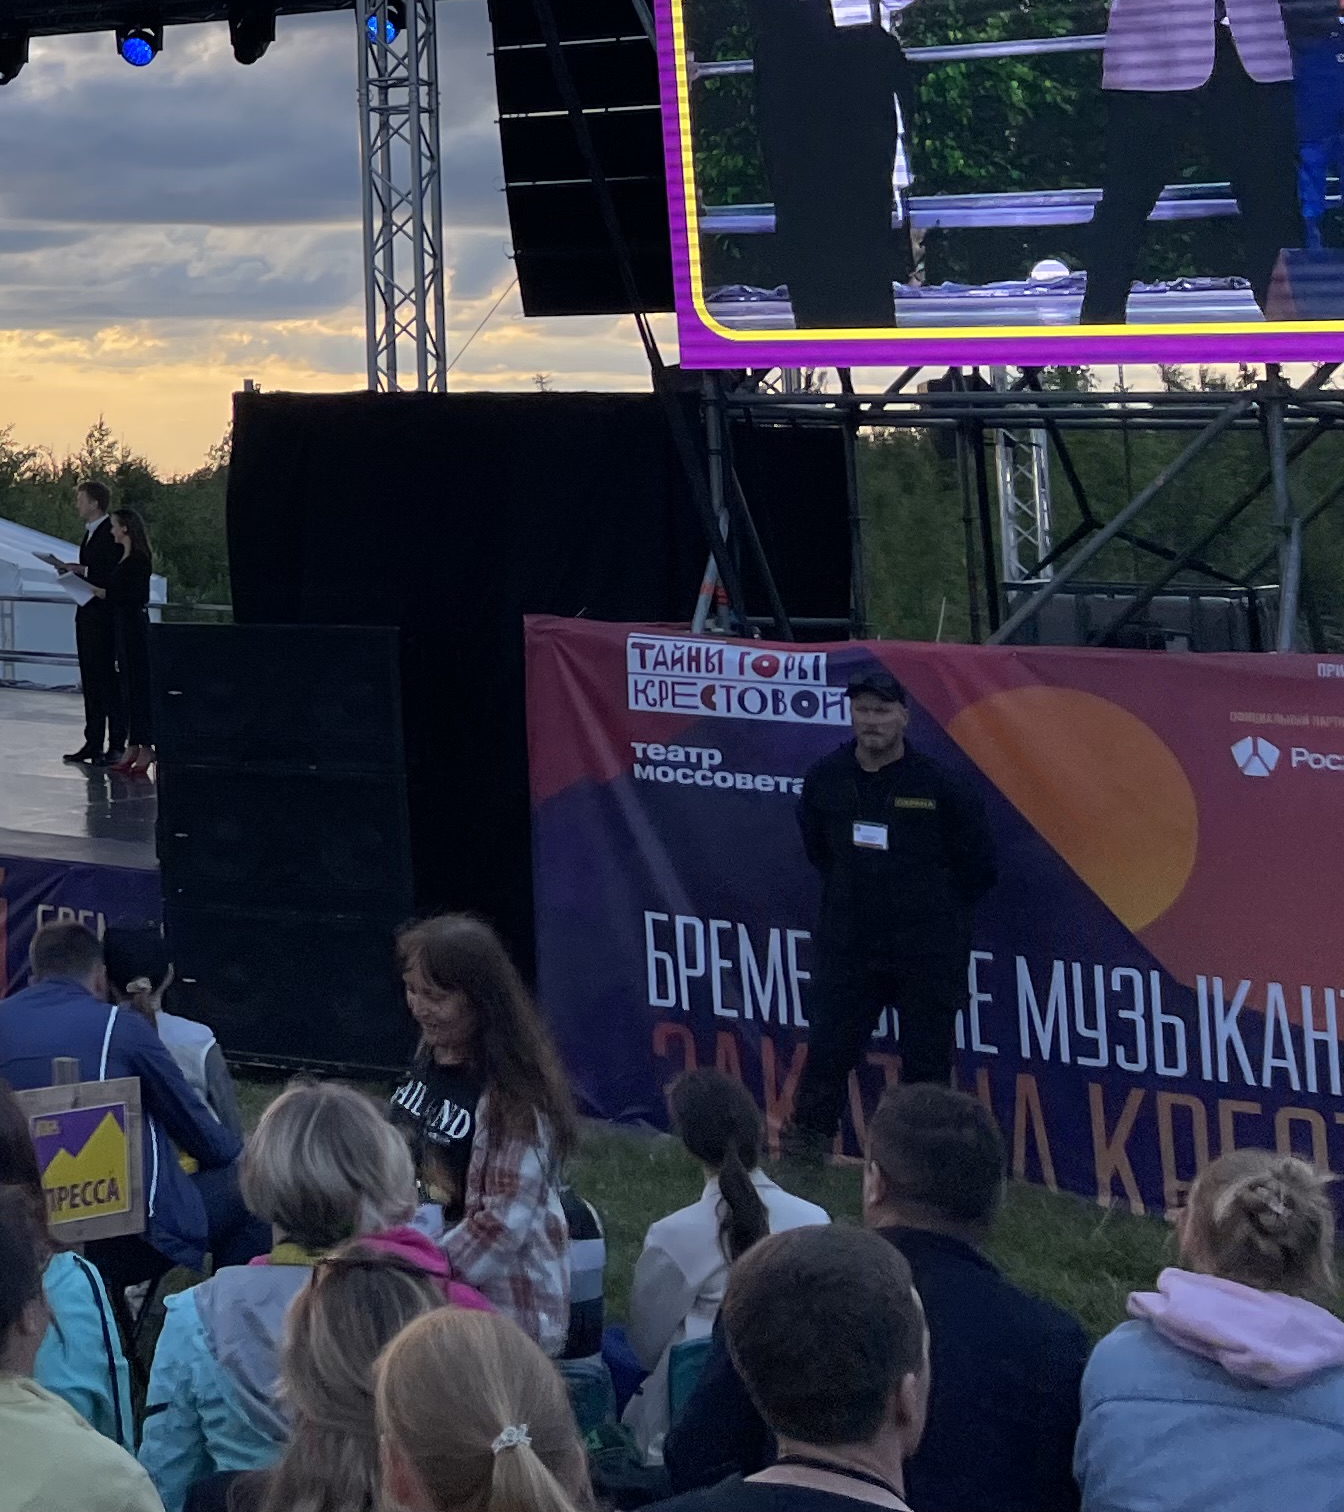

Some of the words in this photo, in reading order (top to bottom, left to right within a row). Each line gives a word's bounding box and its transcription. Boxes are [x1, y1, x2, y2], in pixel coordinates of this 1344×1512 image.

[631, 641, 724, 675] ТАЙНЫ
[739, 651, 821, 681] ГОРЫ
[633, 678, 846, 720] КРЕСТОВОЙ
[631, 741, 722, 769] театр
[1291, 746, 1344, 771] Рос
[1015, 954, 1344, 1096] МУЗЫКАН
